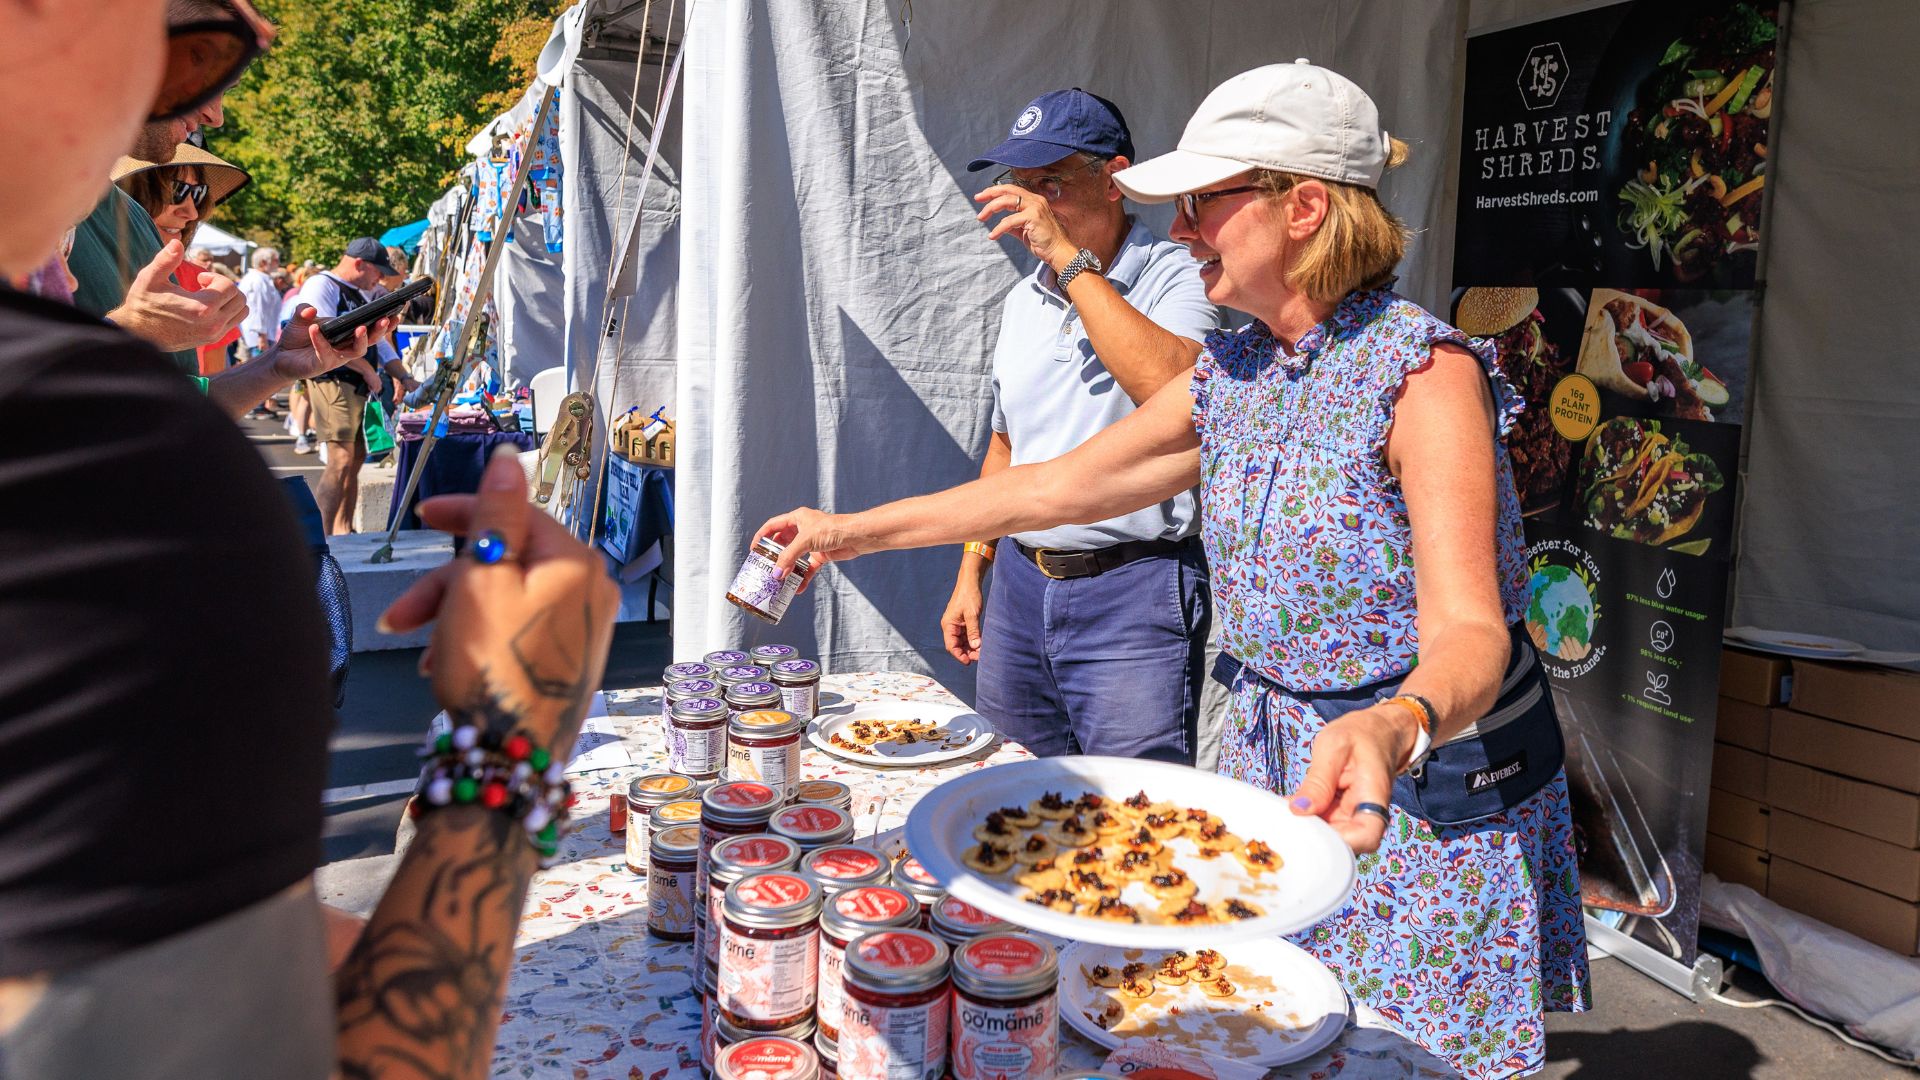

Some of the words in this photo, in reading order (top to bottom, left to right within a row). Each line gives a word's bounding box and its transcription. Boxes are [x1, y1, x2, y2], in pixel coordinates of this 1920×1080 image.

[1475, 111, 1611, 151] HARVEST
[1476, 189, 1599, 209] HarvestShreds.com
[1571, 388, 1585, 401] 16g
[1561, 397, 1591, 413] PLANT
[1555, 406, 1593, 425] PROTEIN
[1526, 539, 1561, 559] Better
[1562, 539, 1581, 557] for
[1582, 550, 1601, 582] You.
[1639, 596, 1651, 606] less
[1651, 599, 1665, 610] blue
[1665, 605, 1684, 615] water
[1552, 662, 1571, 679] the
[1571, 644, 1608, 679] Planet.
[1653, 652, 1666, 663] less
[1636, 698, 1662, 713] required
[1663, 708, 1679, 719] land
